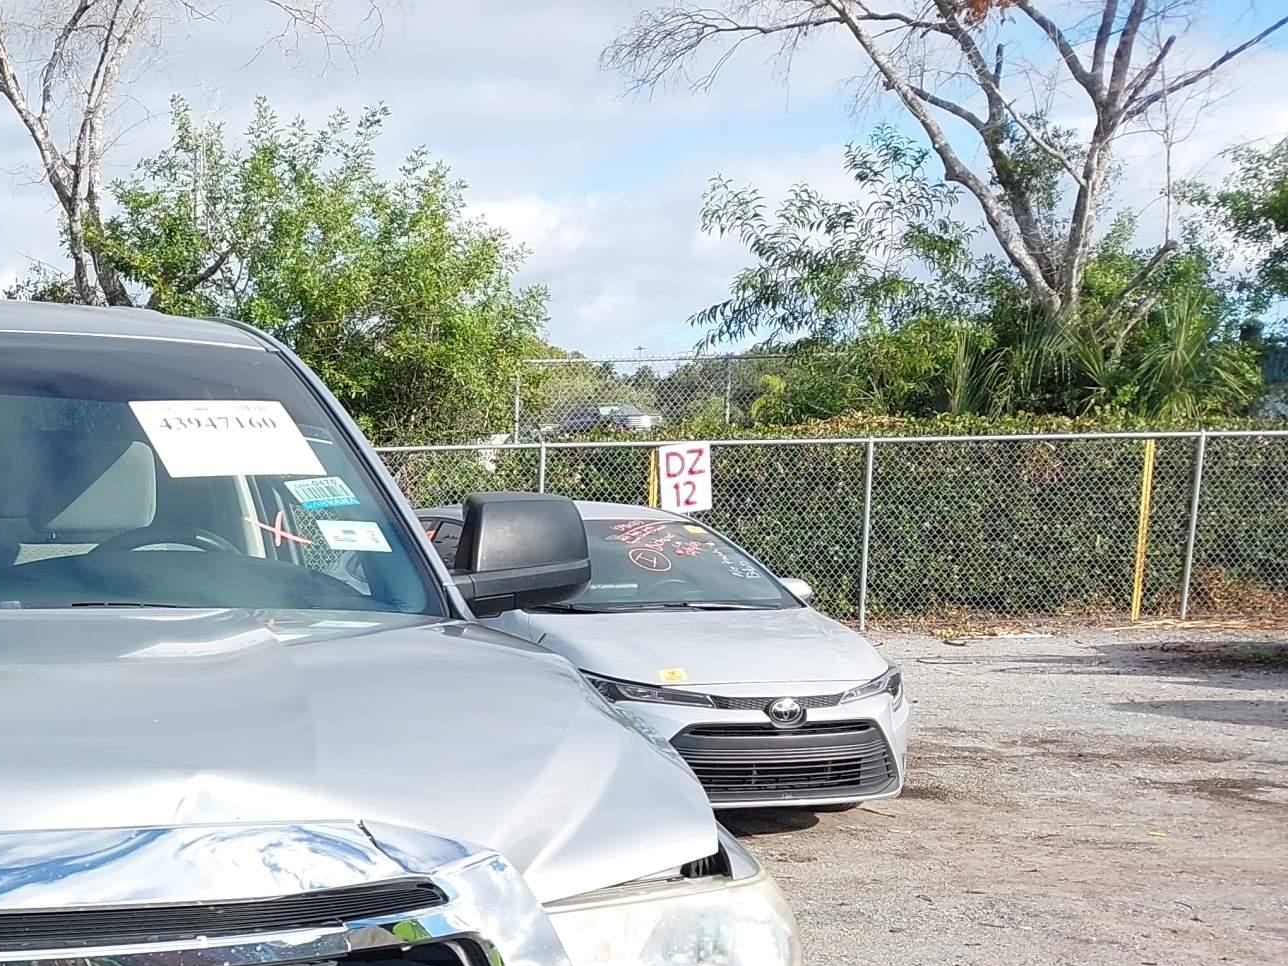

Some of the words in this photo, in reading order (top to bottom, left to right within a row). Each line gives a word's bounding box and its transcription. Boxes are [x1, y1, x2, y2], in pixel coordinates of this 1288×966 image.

[159, 416, 278, 431] 43947160
[665, 448, 705, 478] DZ
[673, 481, 698, 507] 12
